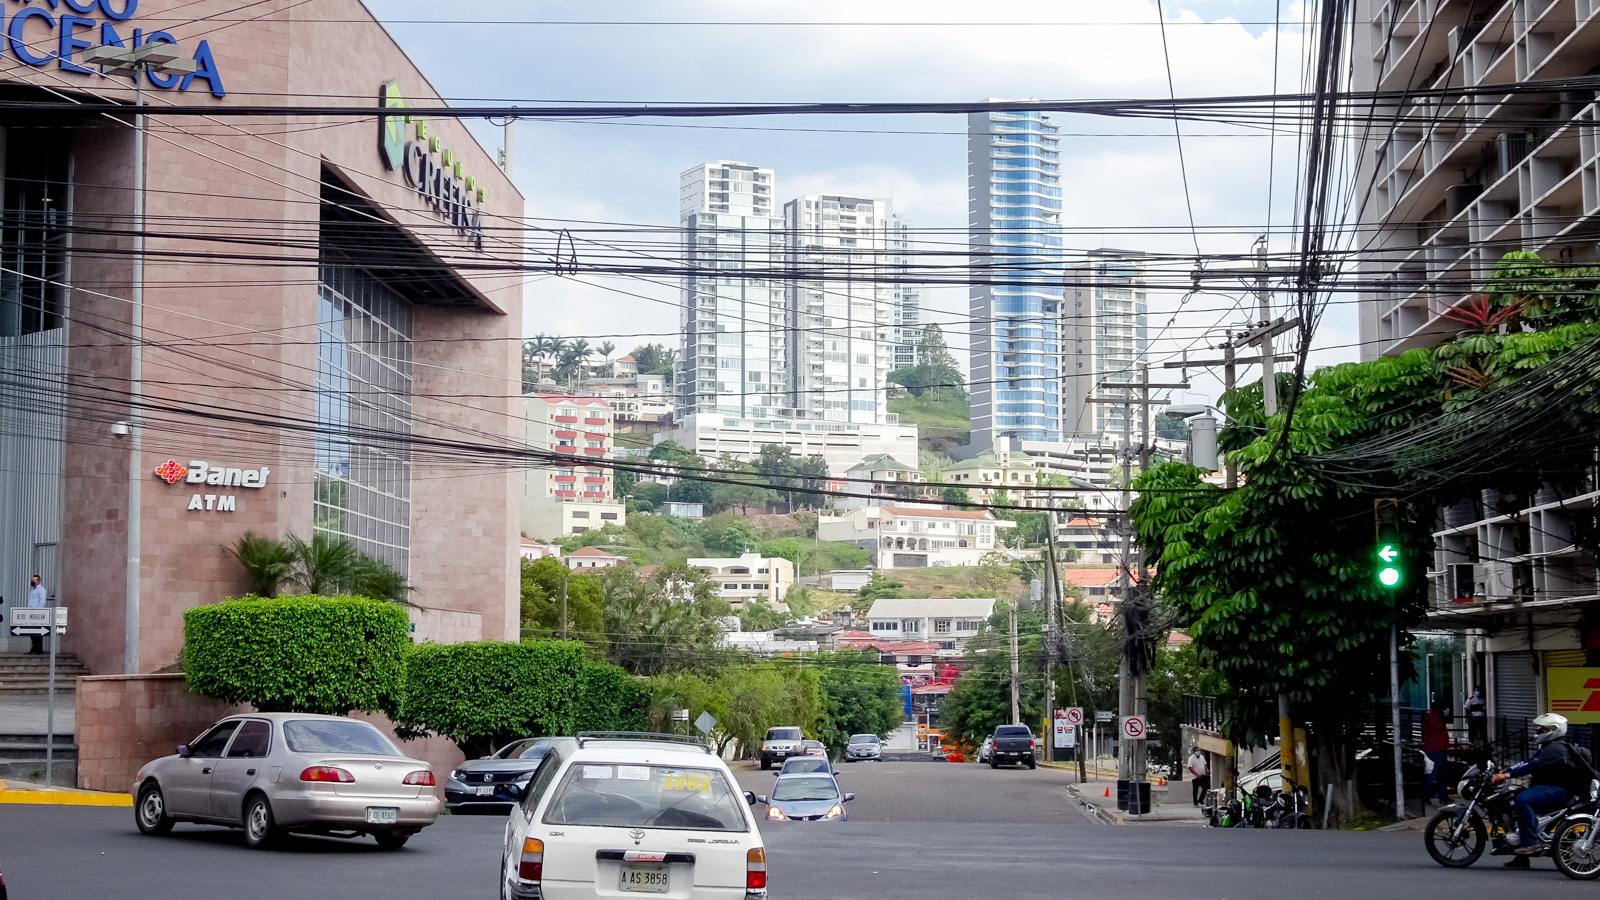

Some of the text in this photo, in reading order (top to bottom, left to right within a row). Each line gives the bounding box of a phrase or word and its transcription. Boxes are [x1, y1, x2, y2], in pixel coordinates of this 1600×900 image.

[186, 460, 271, 488] Banet
[187, 494, 236, 512] ATM
[644, 872, 668, 885] 3858
